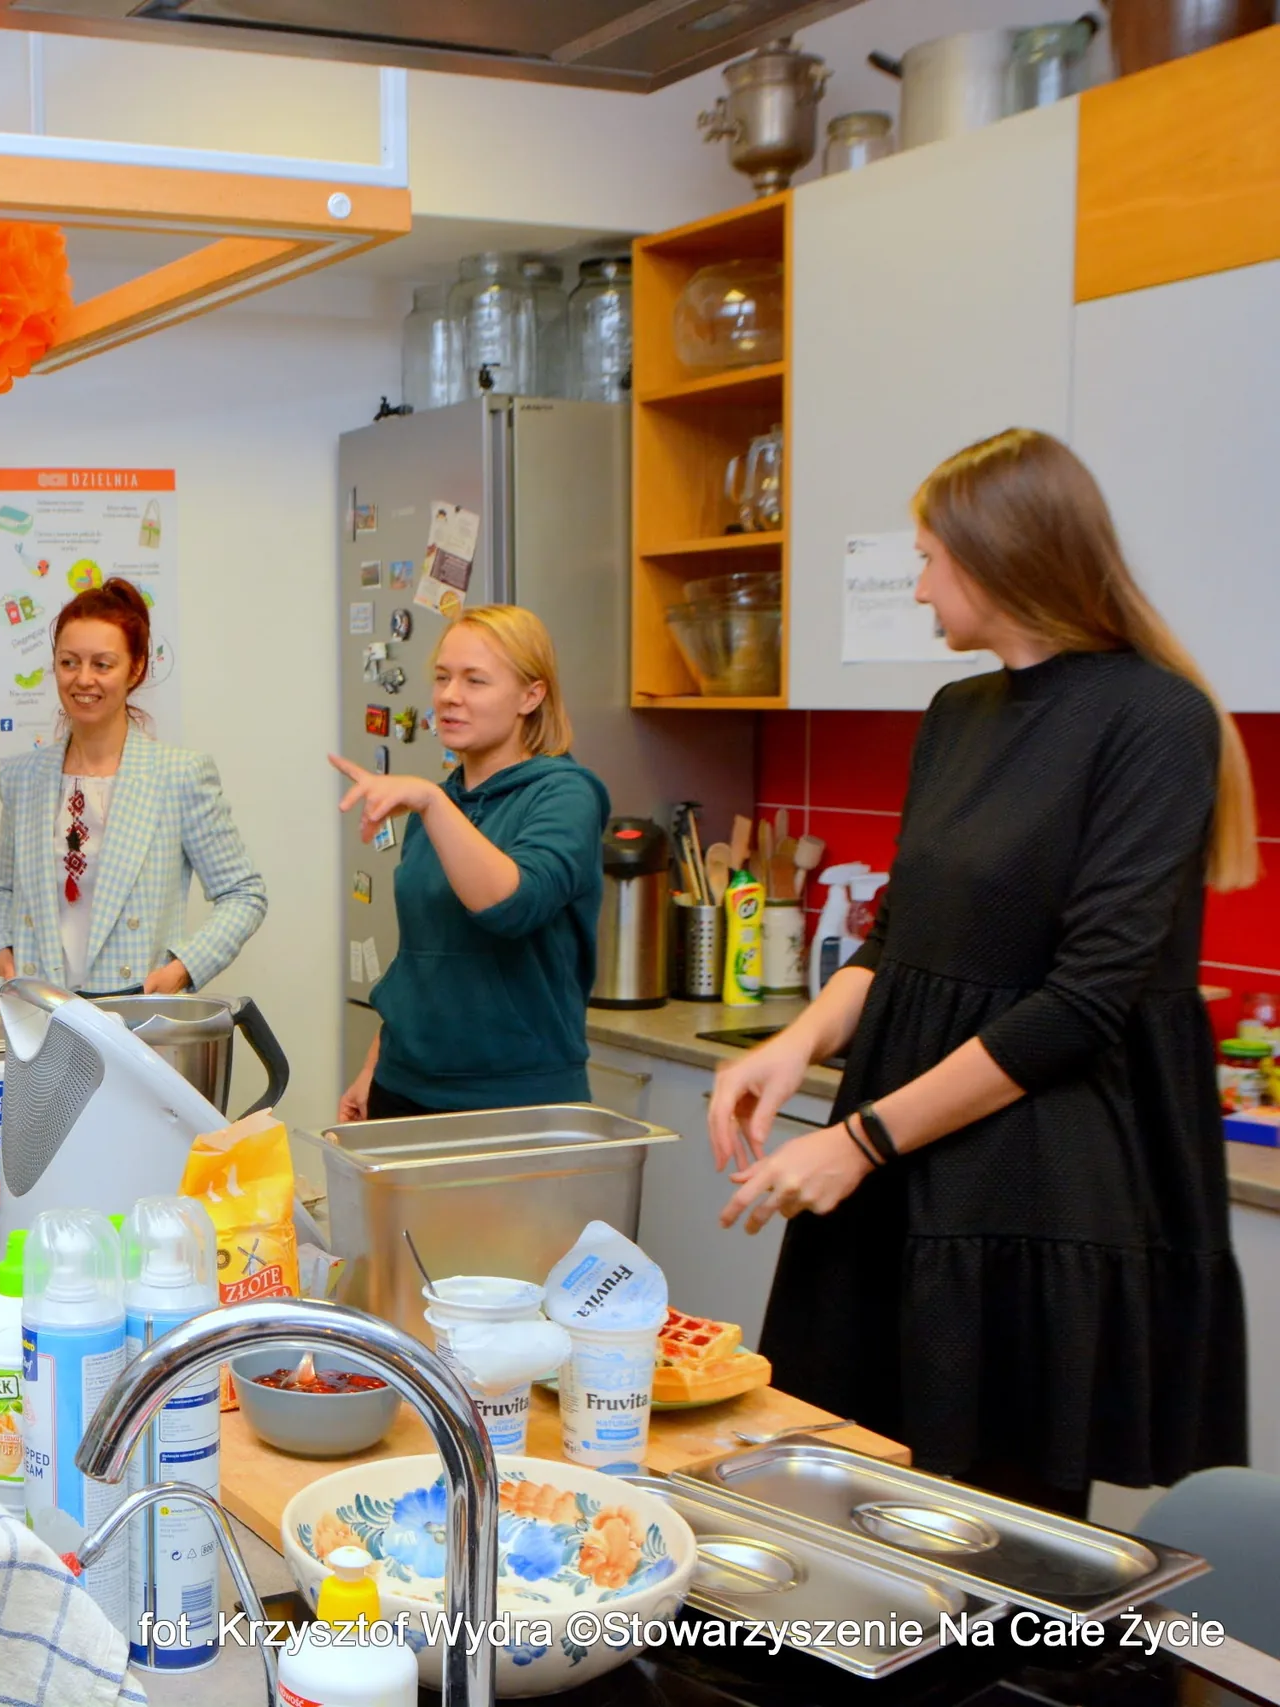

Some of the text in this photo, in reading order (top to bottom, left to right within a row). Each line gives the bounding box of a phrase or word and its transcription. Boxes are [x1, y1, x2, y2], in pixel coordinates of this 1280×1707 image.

[71, 473, 139, 488] DZIELNIA
[225, 1267, 281, 1303] ZŁOTE
[576, 1263, 634, 1318] Fruvita
[585, 1392, 648, 1411] Fruvita
